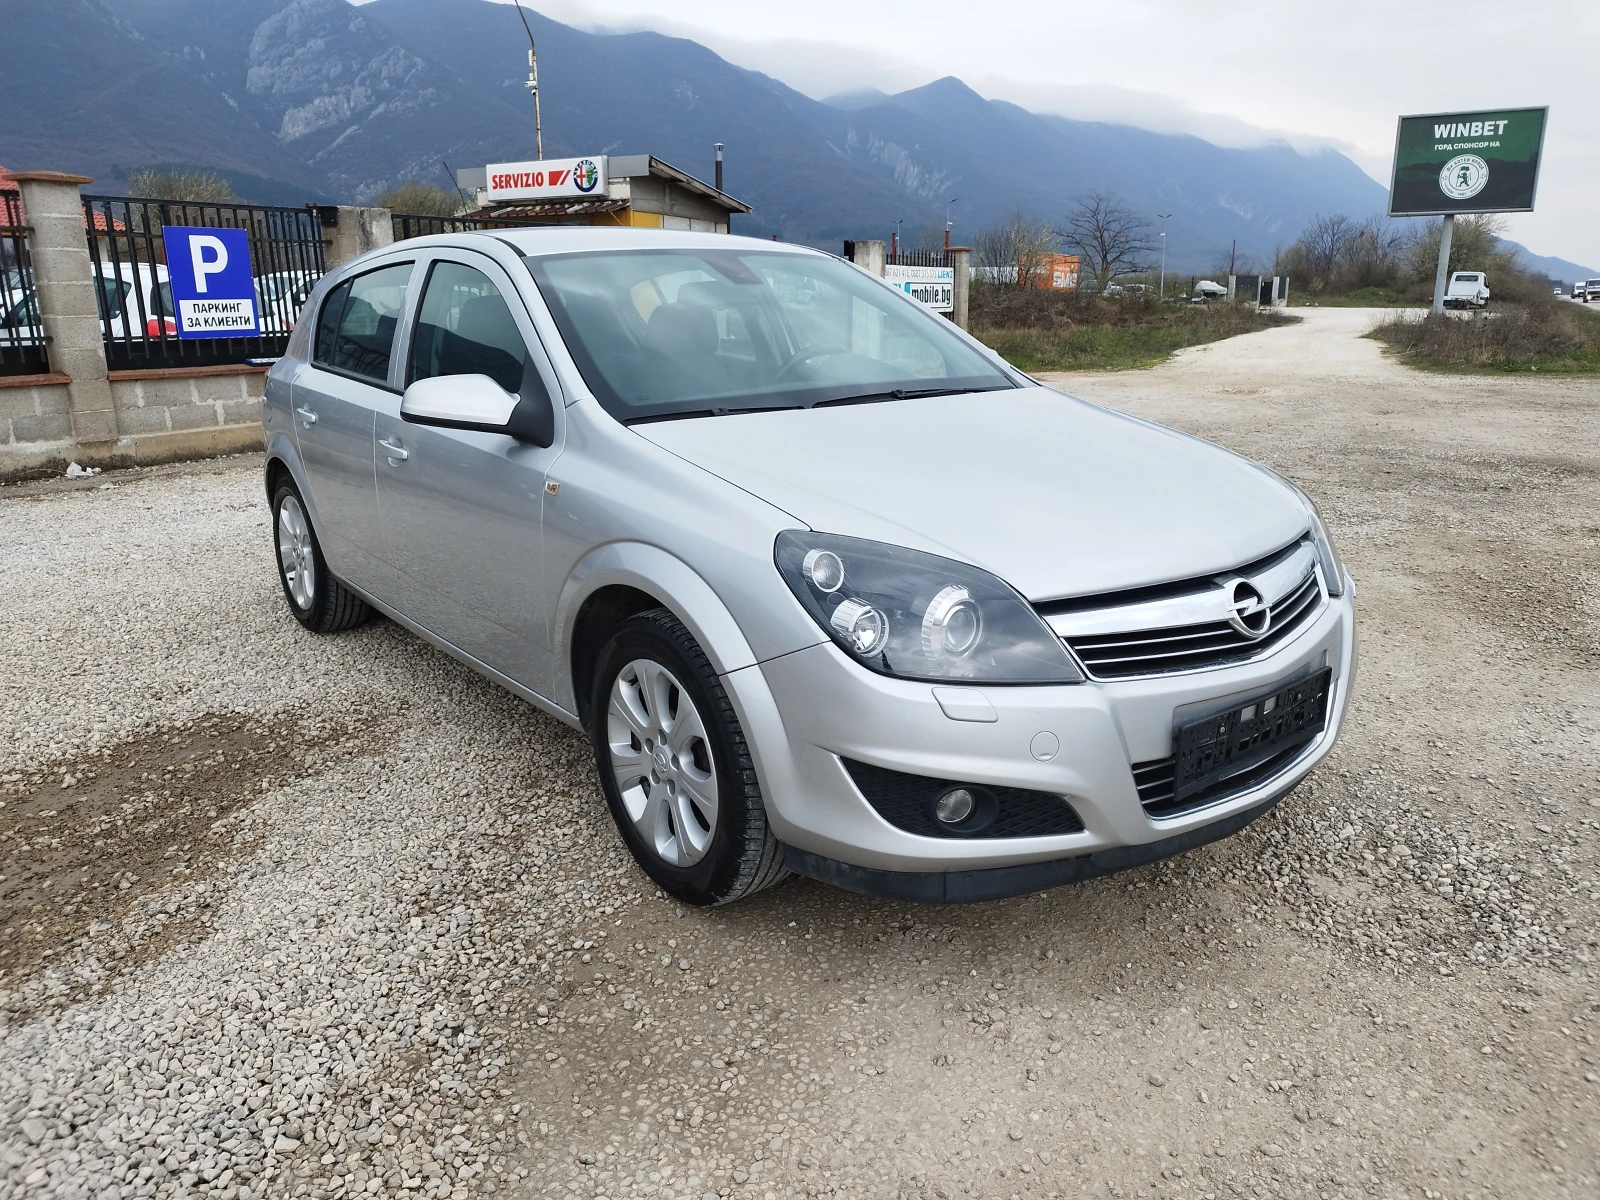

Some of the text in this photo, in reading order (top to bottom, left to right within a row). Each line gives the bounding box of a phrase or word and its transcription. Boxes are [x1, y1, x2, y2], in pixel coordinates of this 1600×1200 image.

[1434, 120, 1508, 138] WINBET
[1434, 143, 1453, 151] ГОРД
[491, 171, 544, 190] SERVIZIO
[188, 234, 229, 293] P
[937, 270, 953, 279] LIENZ
[911, 286, 951, 305] mobile.bg
[193, 303, 242, 313] ПАРКИНГ
[187, 316, 251, 328] ЗА КЛИЕНТИ
